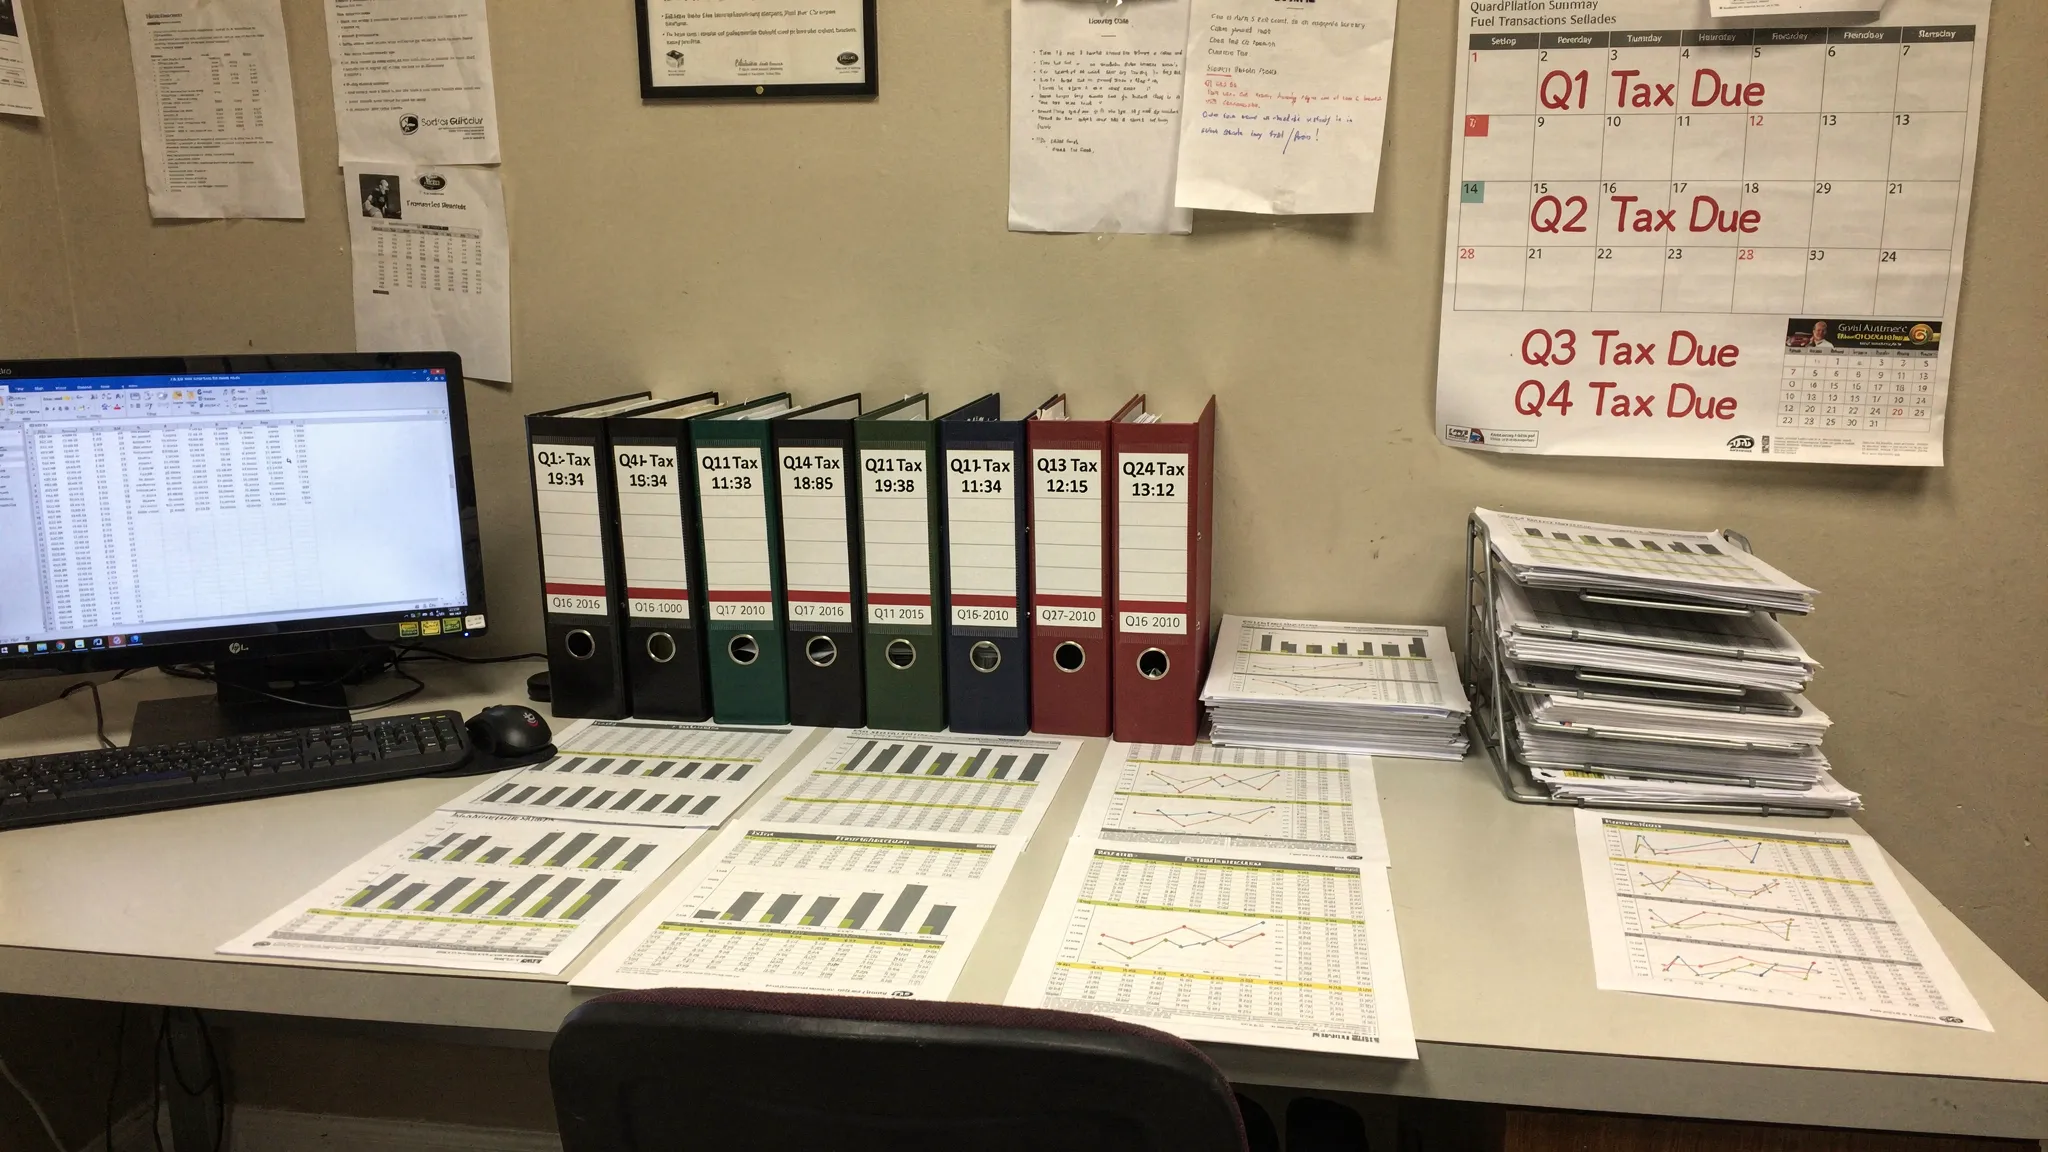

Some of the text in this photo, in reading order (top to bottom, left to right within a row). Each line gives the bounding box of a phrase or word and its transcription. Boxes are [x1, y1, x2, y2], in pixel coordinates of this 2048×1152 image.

[1471, 16, 1495, 27] Fuel
[1499, 15, 1567, 26] Transactions
[1541, 51, 1548, 61] 2
[1611, 50, 1618, 60] 3
[1682, 49, 1690, 58] 4
[1755, 47, 1762, 59] 5
[1828, 46, 1836, 57] 6
[1904, 45, 1911, 56] 7
[1472, 53, 1477, 62] 1
[1540, 69, 1765, 110] Q1 Tax Due
[1538, 117, 1544, 127] 9
[1607, 116, 1621, 126] 10
[1678, 116, 1689, 126] 11
[1750, 115, 1763, 126] 12
[1823, 115, 1836, 125] 13
[1896, 115, 1909, 125] 13
[1464, 184, 1478, 193] 14
[1534, 183, 1547, 193] 15
[1603, 183, 1616, 193] 16
[1673, 183, 1687, 193] 17
[1745, 183, 1759, 193] 18
[1816, 183, 1831, 194] 29
[1889, 183, 1902, 194] 21
[1530, 196, 1761, 233] Q2 Tax Due
[1460, 249, 1474, 259] 28
[1529, 249, 1541, 258] 21
[1598, 249, 1612, 259] 22
[1668, 249, 1682, 259] 23
[1881, 251, 1897, 262] 24
[1522, 329, 1739, 367] Q3 Tax Due
[1515, 380, 1737, 419] Q4 Tax Due
[566, 452, 591, 466] Tax
[649, 454, 674, 467] Tax
[702, 456, 758, 471] Q11 Tax
[815, 456, 840, 469] Tax
[896, 459, 922, 472] Tax
[983, 459, 1010, 472] Tax
[1037, 458, 1098, 473] Q13 Tax
[1123, 462, 1185, 477] Q24 Tax
[875, 479, 914, 492] 19:38
[962, 480, 1002, 492] 11:34
[1047, 479, 1088, 493] 12:15
[1132, 483, 1174, 496] 13:12
[576, 599, 600, 609] 2016
[716, 605, 765, 616] Q17 2010
[795, 605, 844, 616] Q17 2016
[874, 608, 924, 620] Q11 2015
[1152, 617, 1180, 627] 2010
